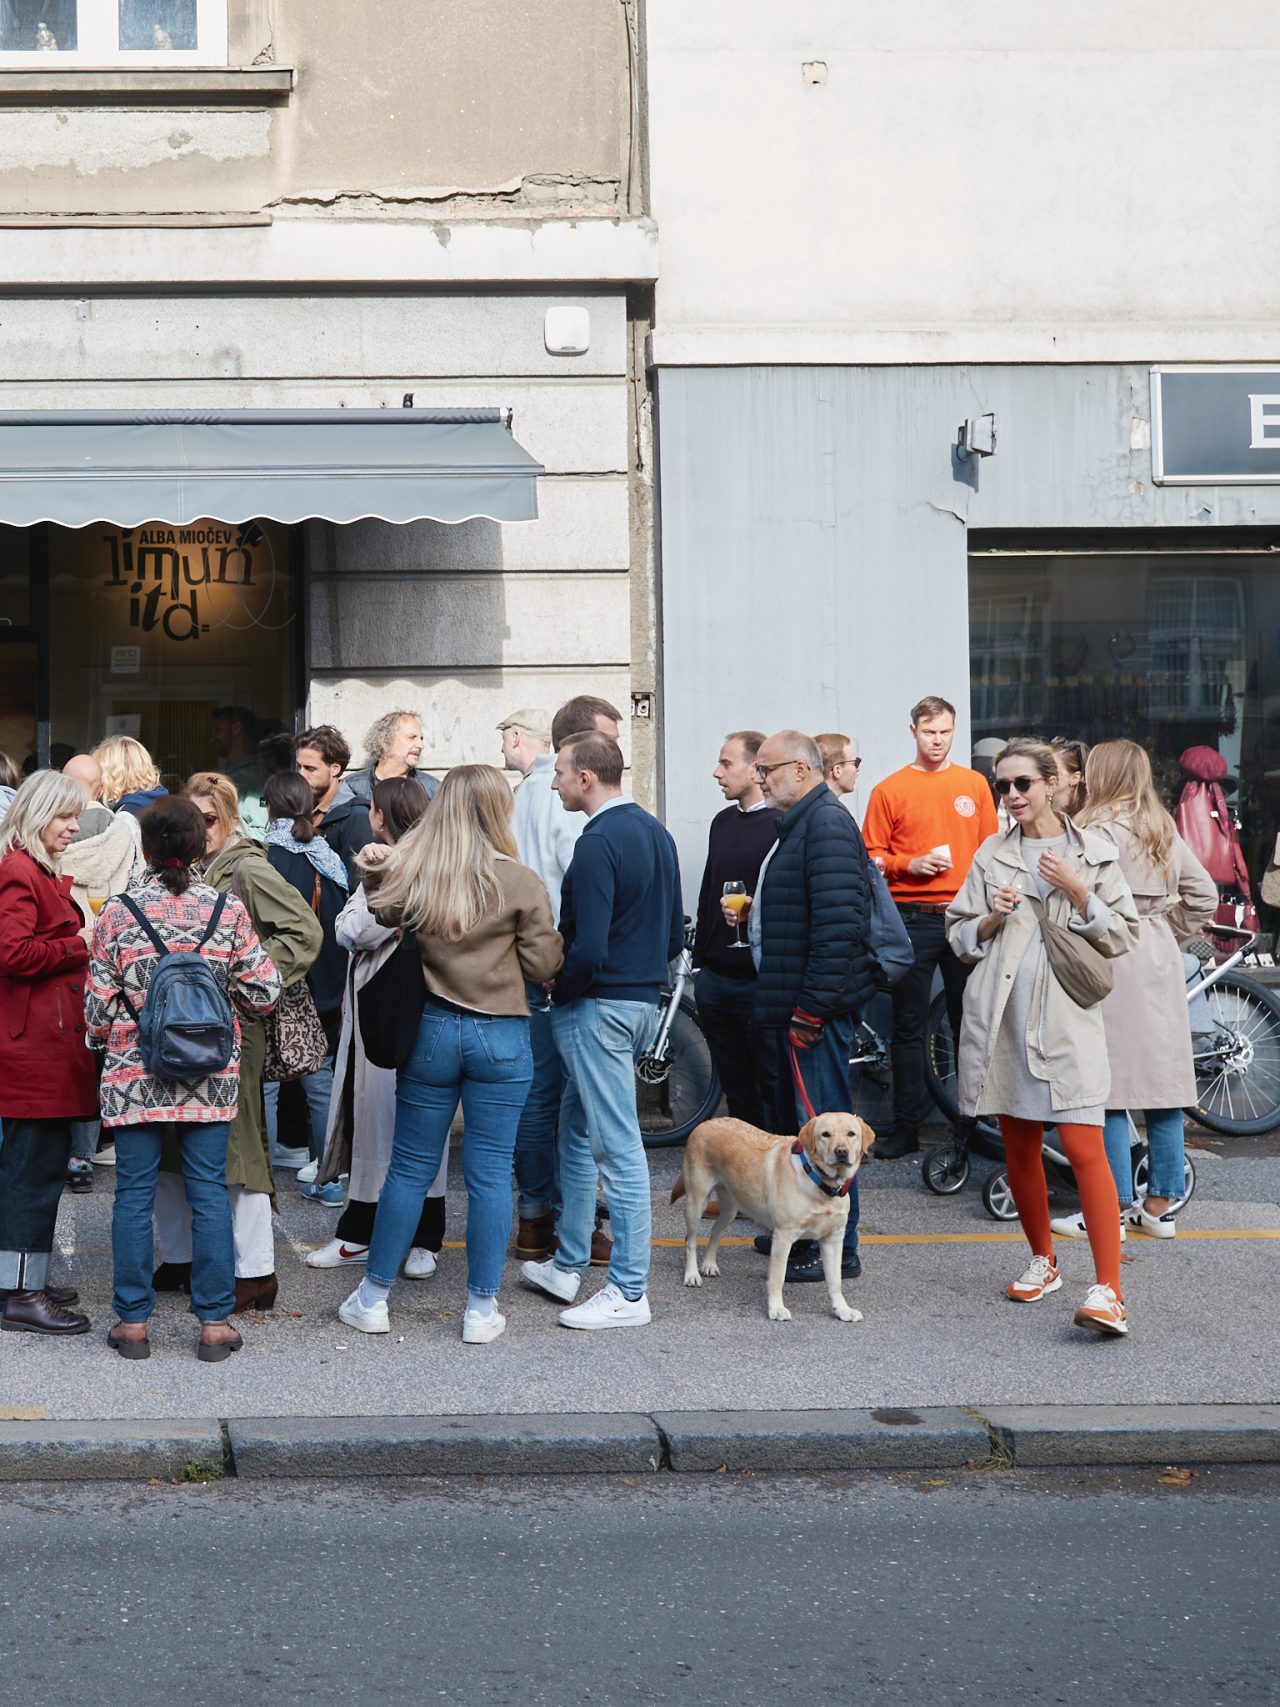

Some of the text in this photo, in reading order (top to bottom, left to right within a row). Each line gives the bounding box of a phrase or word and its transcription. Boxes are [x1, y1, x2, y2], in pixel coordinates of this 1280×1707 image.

[139, 526, 233, 545] ALBA MIOČEV
[103, 528, 257, 600] limun
